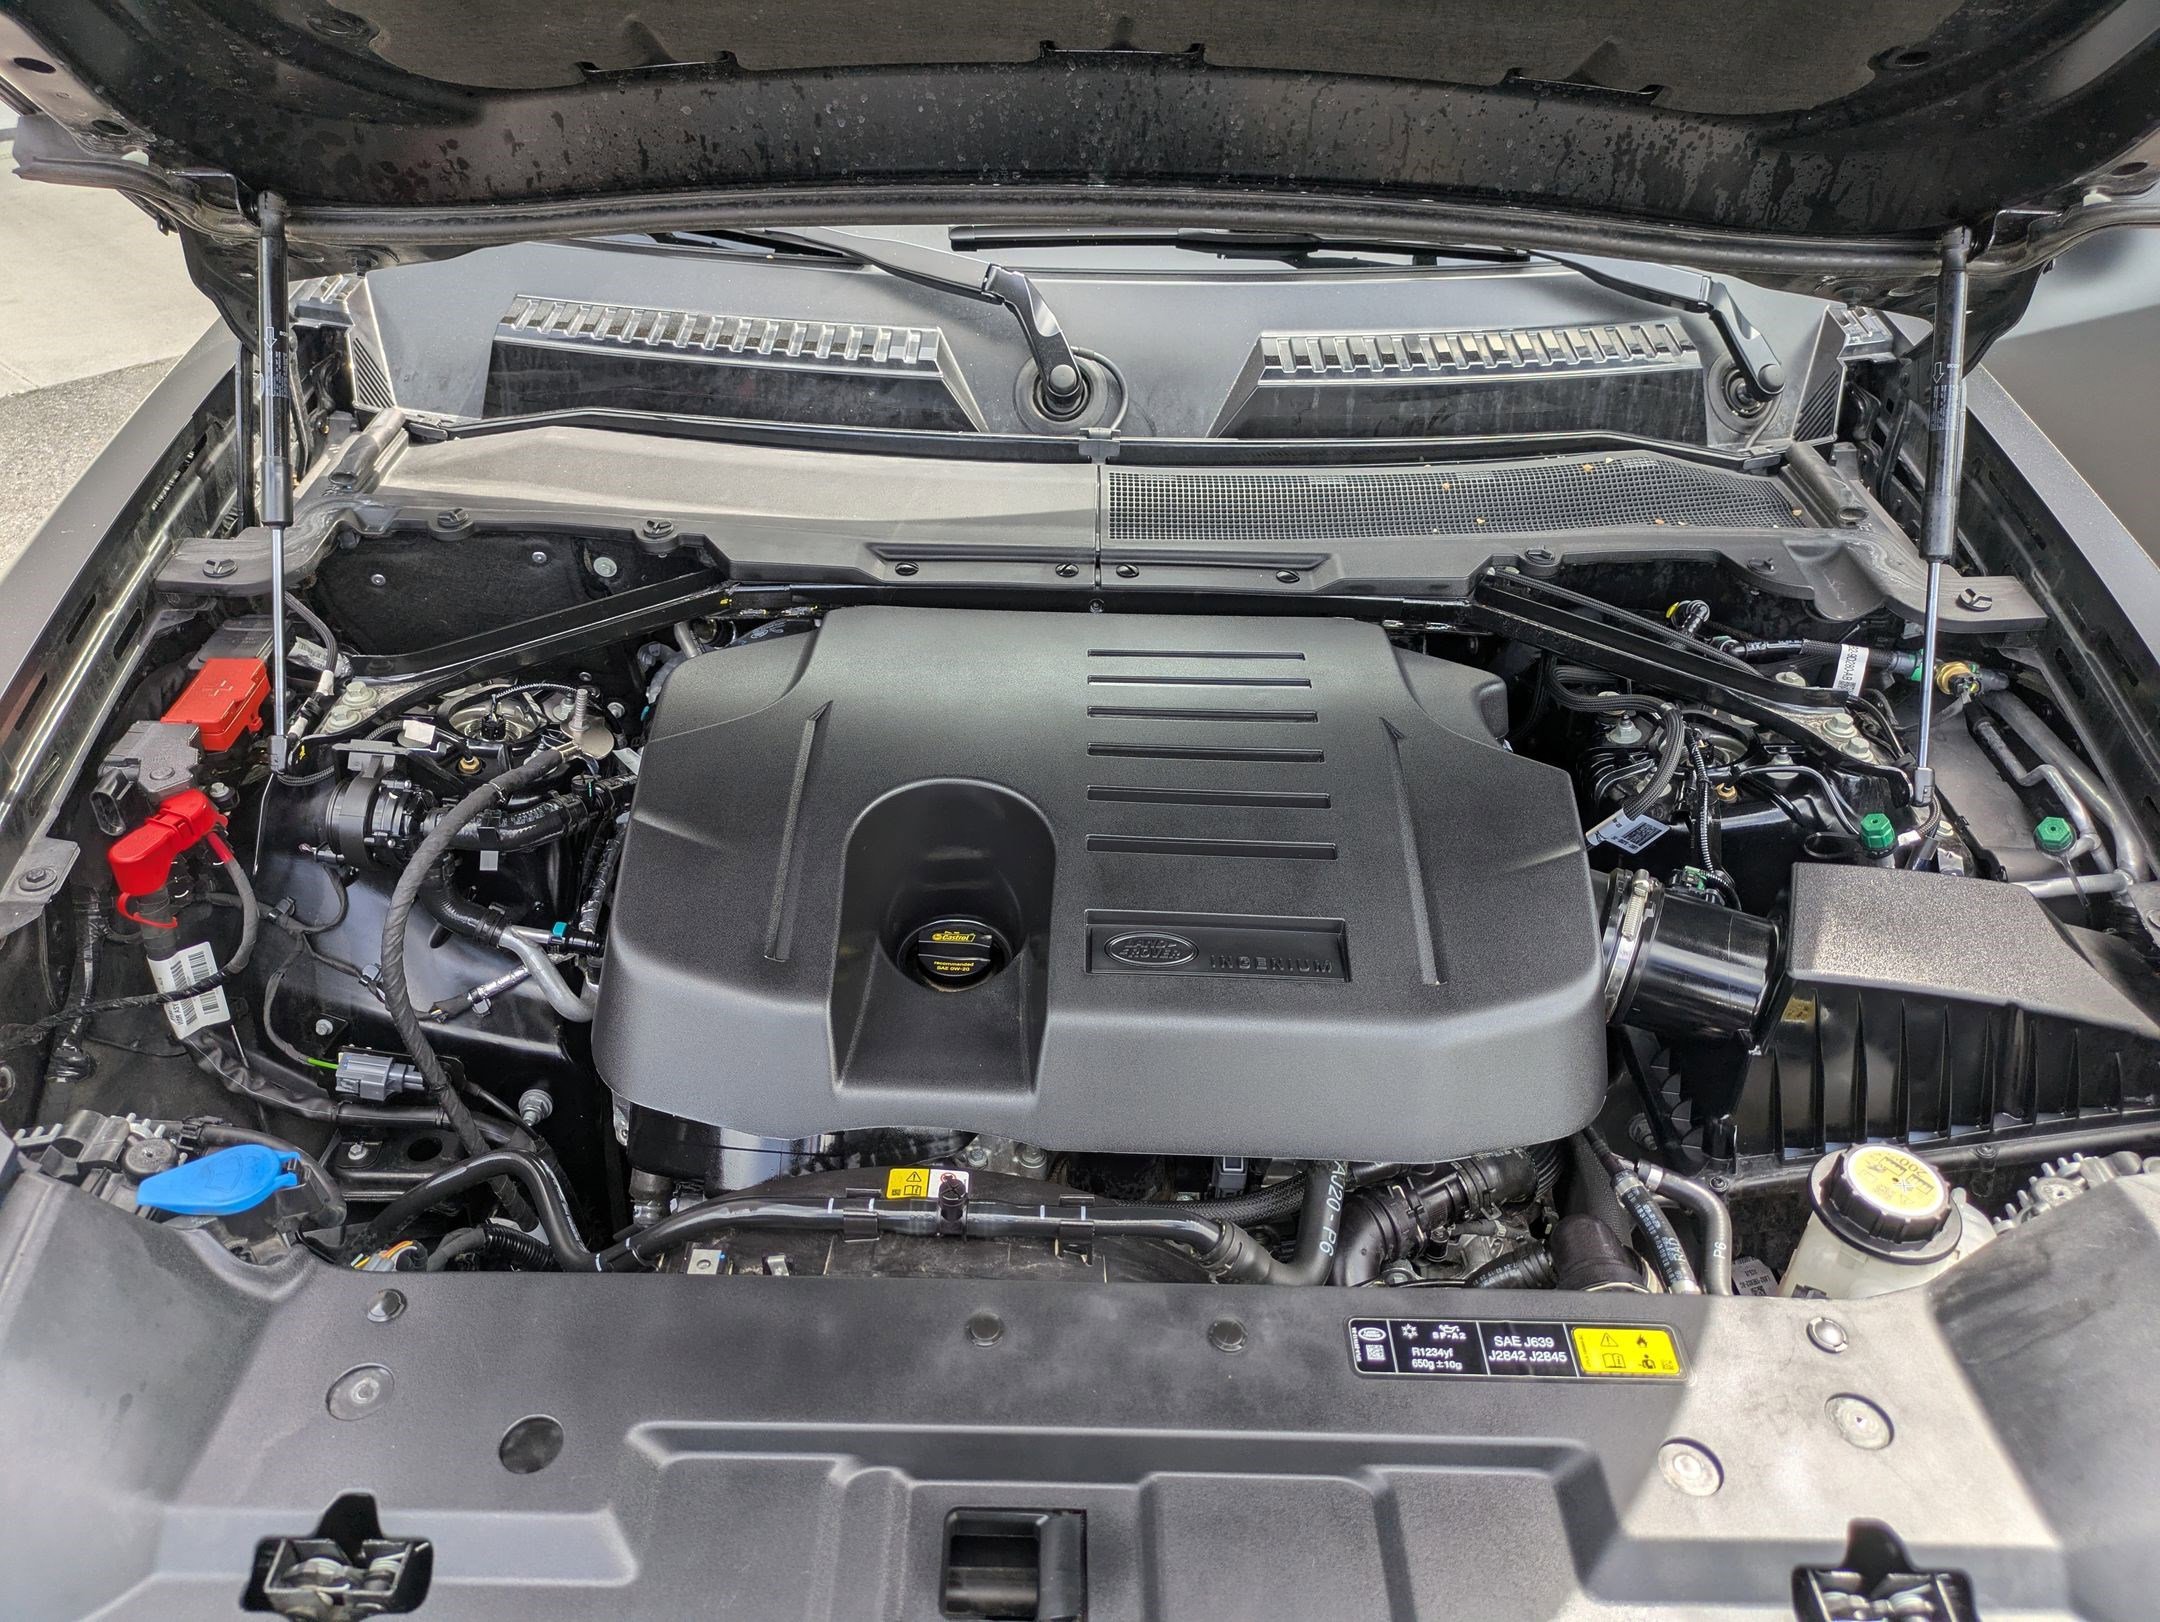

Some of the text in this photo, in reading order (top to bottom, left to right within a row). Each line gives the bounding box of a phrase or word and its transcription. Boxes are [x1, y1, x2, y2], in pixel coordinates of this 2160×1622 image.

[1128, 949, 1181, 960] ROVER
[1319, 1226, 1337, 1257] P6
[1713, 1241, 1727, 1260] P6
[1493, 1335, 1554, 1348] SAE J639
[1411, 1346, 1454, 1359] R1234yf
[1488, 1350, 1568, 1363] J2842 J2845
[1411, 1358, 1463, 1370] 650g ±10g
